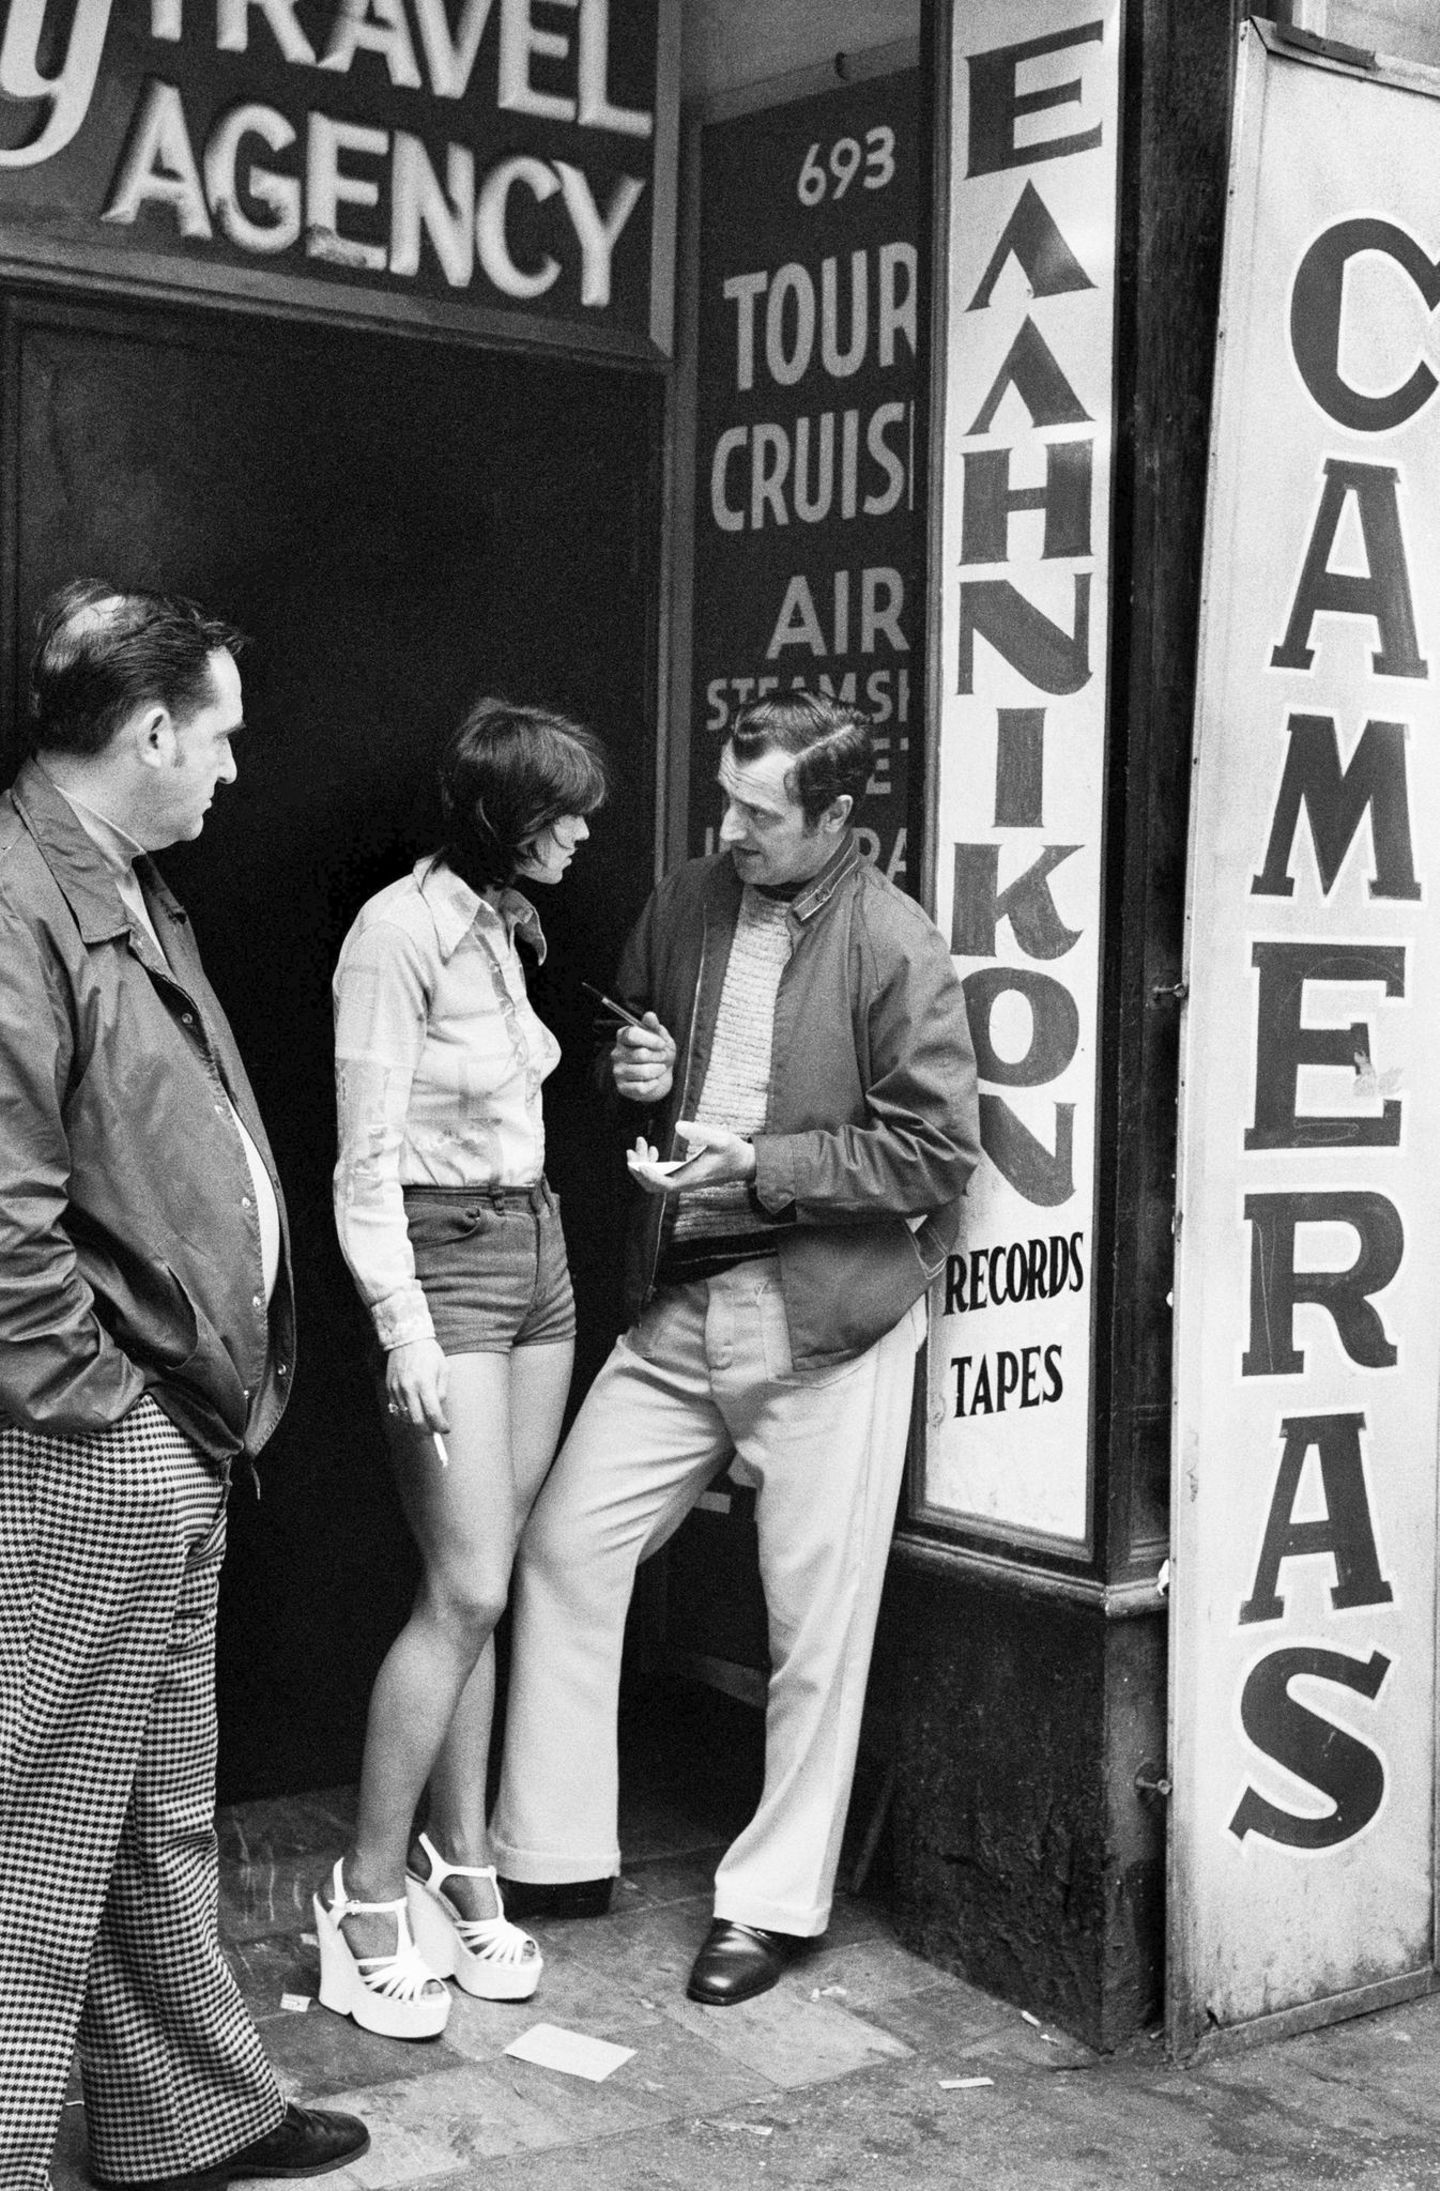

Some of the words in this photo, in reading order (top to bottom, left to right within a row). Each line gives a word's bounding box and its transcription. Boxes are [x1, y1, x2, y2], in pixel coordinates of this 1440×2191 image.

[100, 80, 646, 308] AGENCY
[797, 126, 896, 207] 693
[766, 566, 911, 660] AIR
[1226, 216, 1440, 1851] CAMERAS
[943, 1231, 1084, 1317] RECORDS
[950, 1344, 1064, 1418] TAPES
